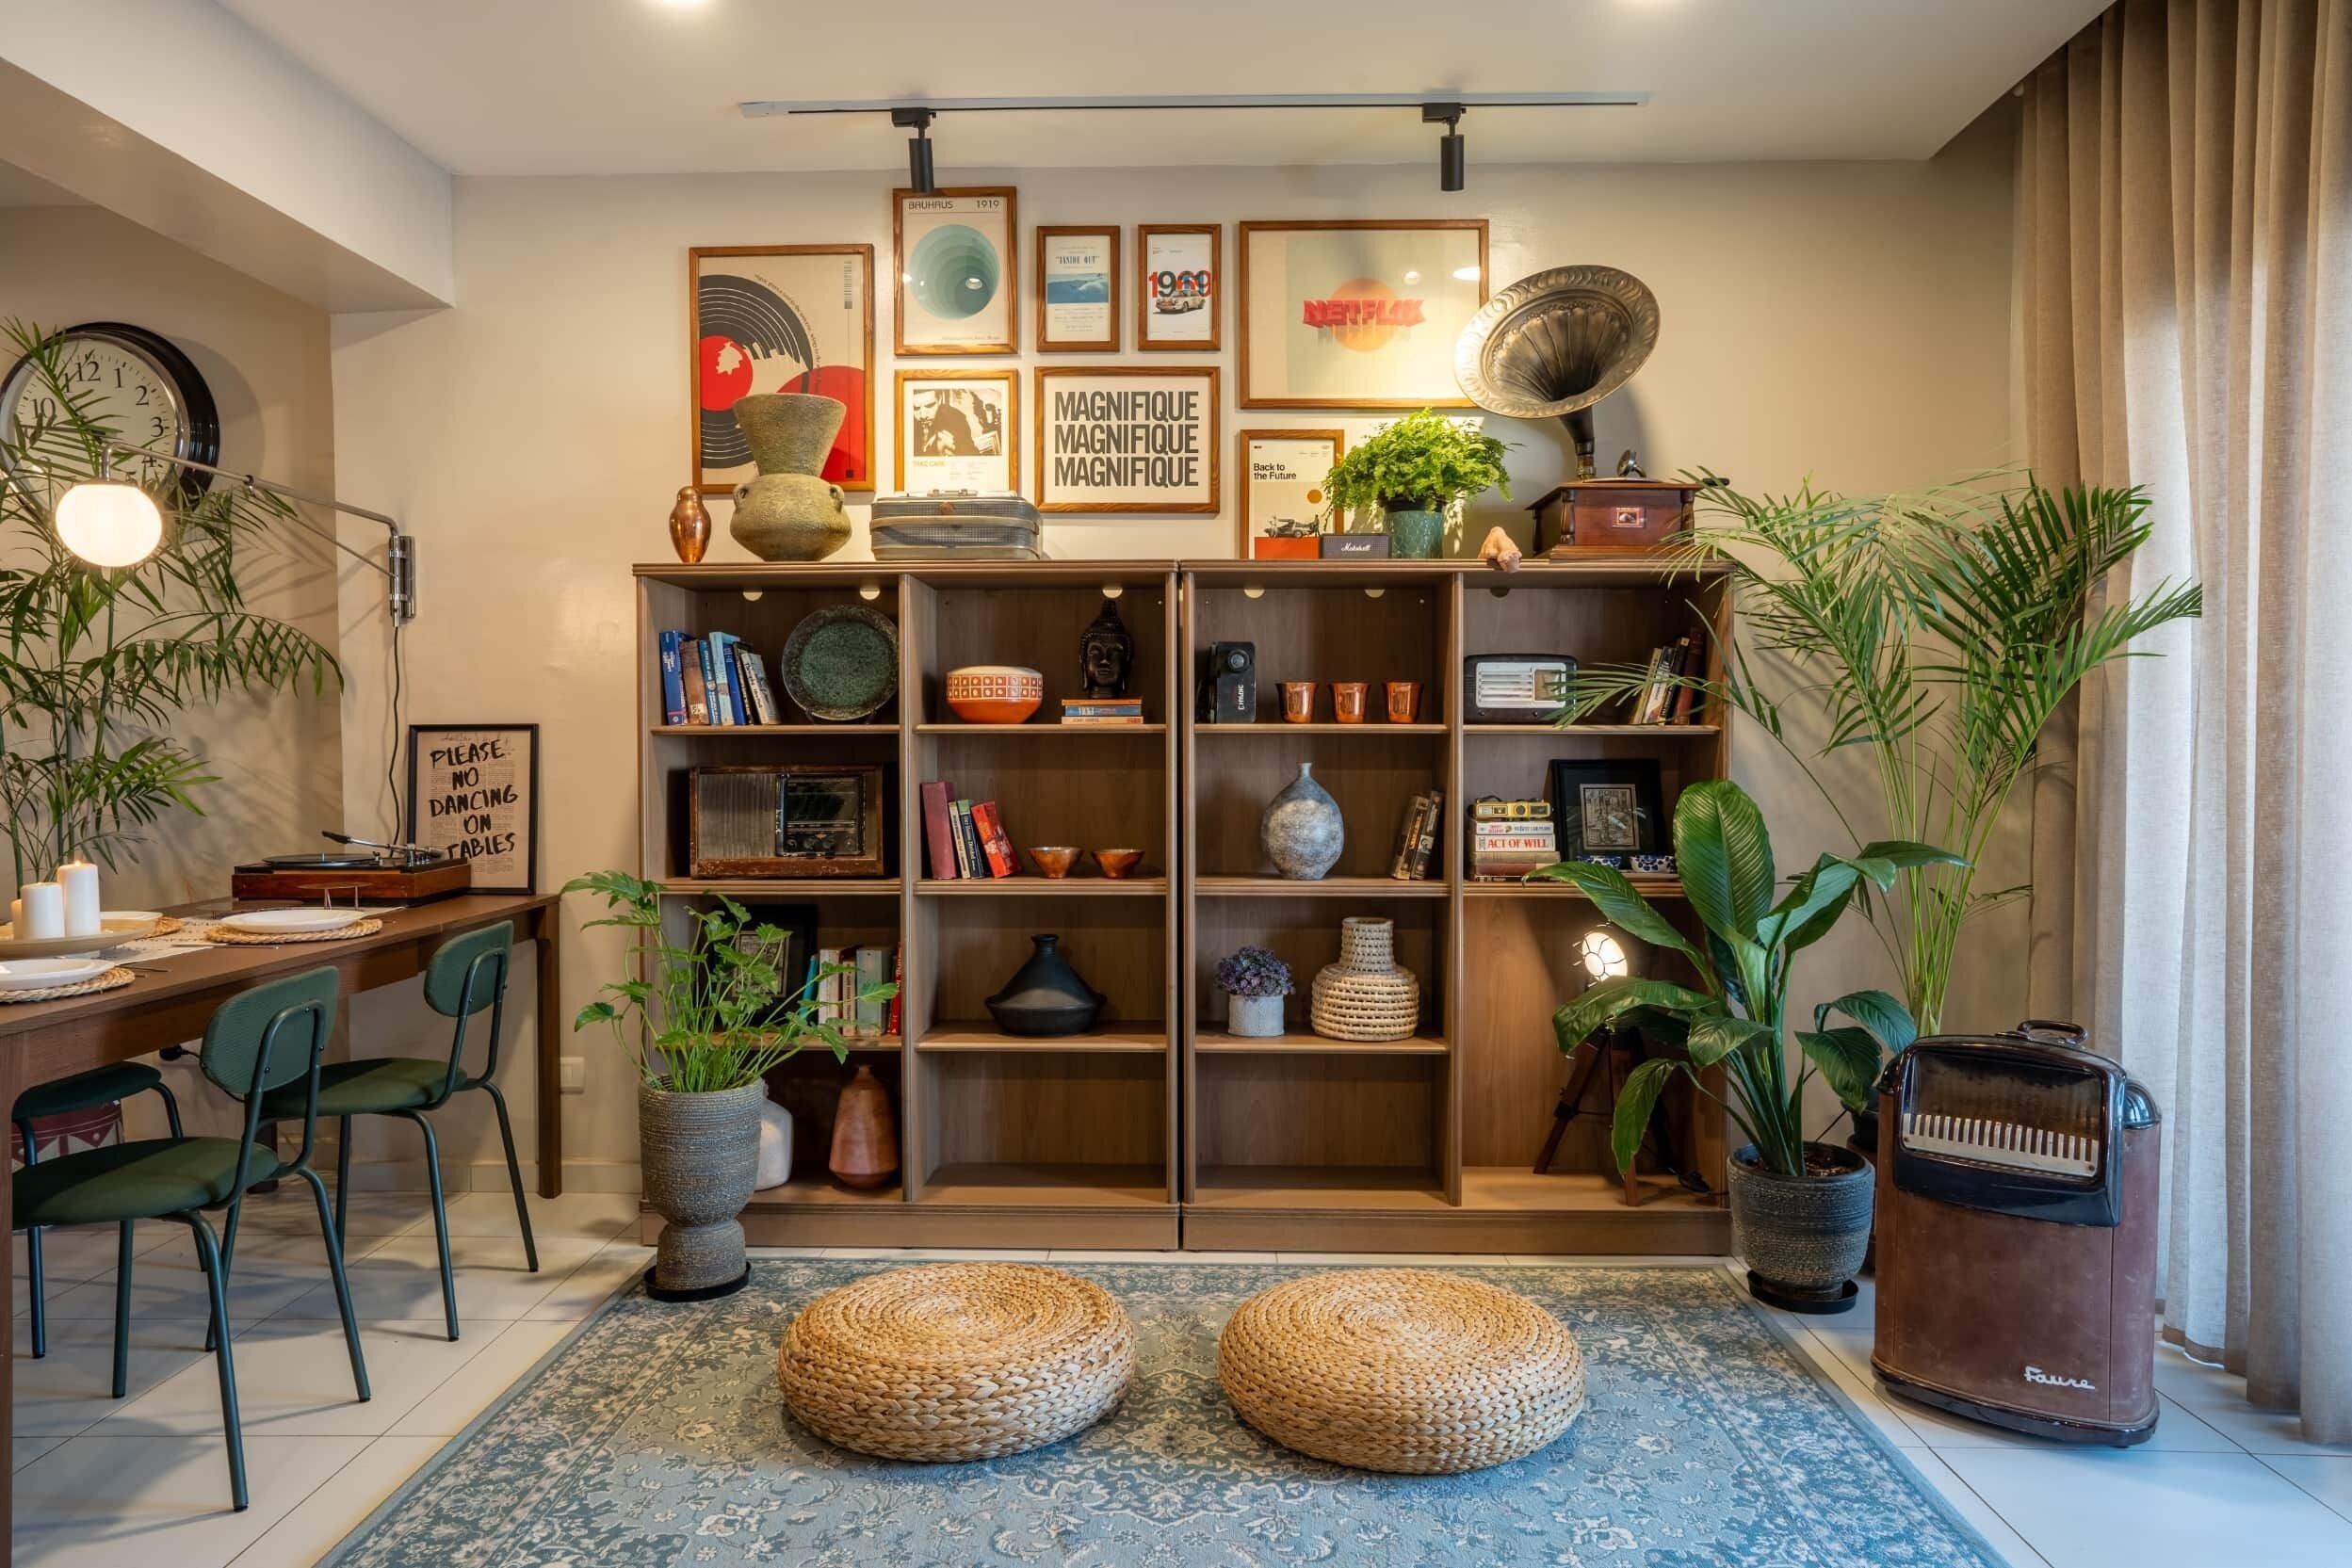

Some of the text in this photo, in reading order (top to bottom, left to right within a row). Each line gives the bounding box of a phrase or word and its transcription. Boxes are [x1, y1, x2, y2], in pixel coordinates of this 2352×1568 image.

[908, 199, 1000, 210] BAUHAUS 1919
[74, 360, 101, 382] 12
[114, 366, 122, 388] 1
[135, 384, 150, 406] 2
[31, 396, 57, 419] 10
[1054, 391, 1199, 423] MAGNIFIQUE
[150, 415, 164, 437] 3
[1054, 424, 1199, 456] MAGNIFIQUE
[1054, 457, 1199, 489] MAGNIFIQUE
[1254, 462, 1286, 472] Back to
[1254, 472, 1297, 480] the Future
[430, 738, 506, 768] PLEASE
[452, 767, 479, 790] NO
[429, 784, 519, 817] DANCING
[463, 814, 492, 834] ON
[446, 832, 516, 860] TABLES
[1488, 839, 1507, 849] ACT
[1508, 839, 1520, 849] OF
[1524, 839, 1547, 849] WILL
